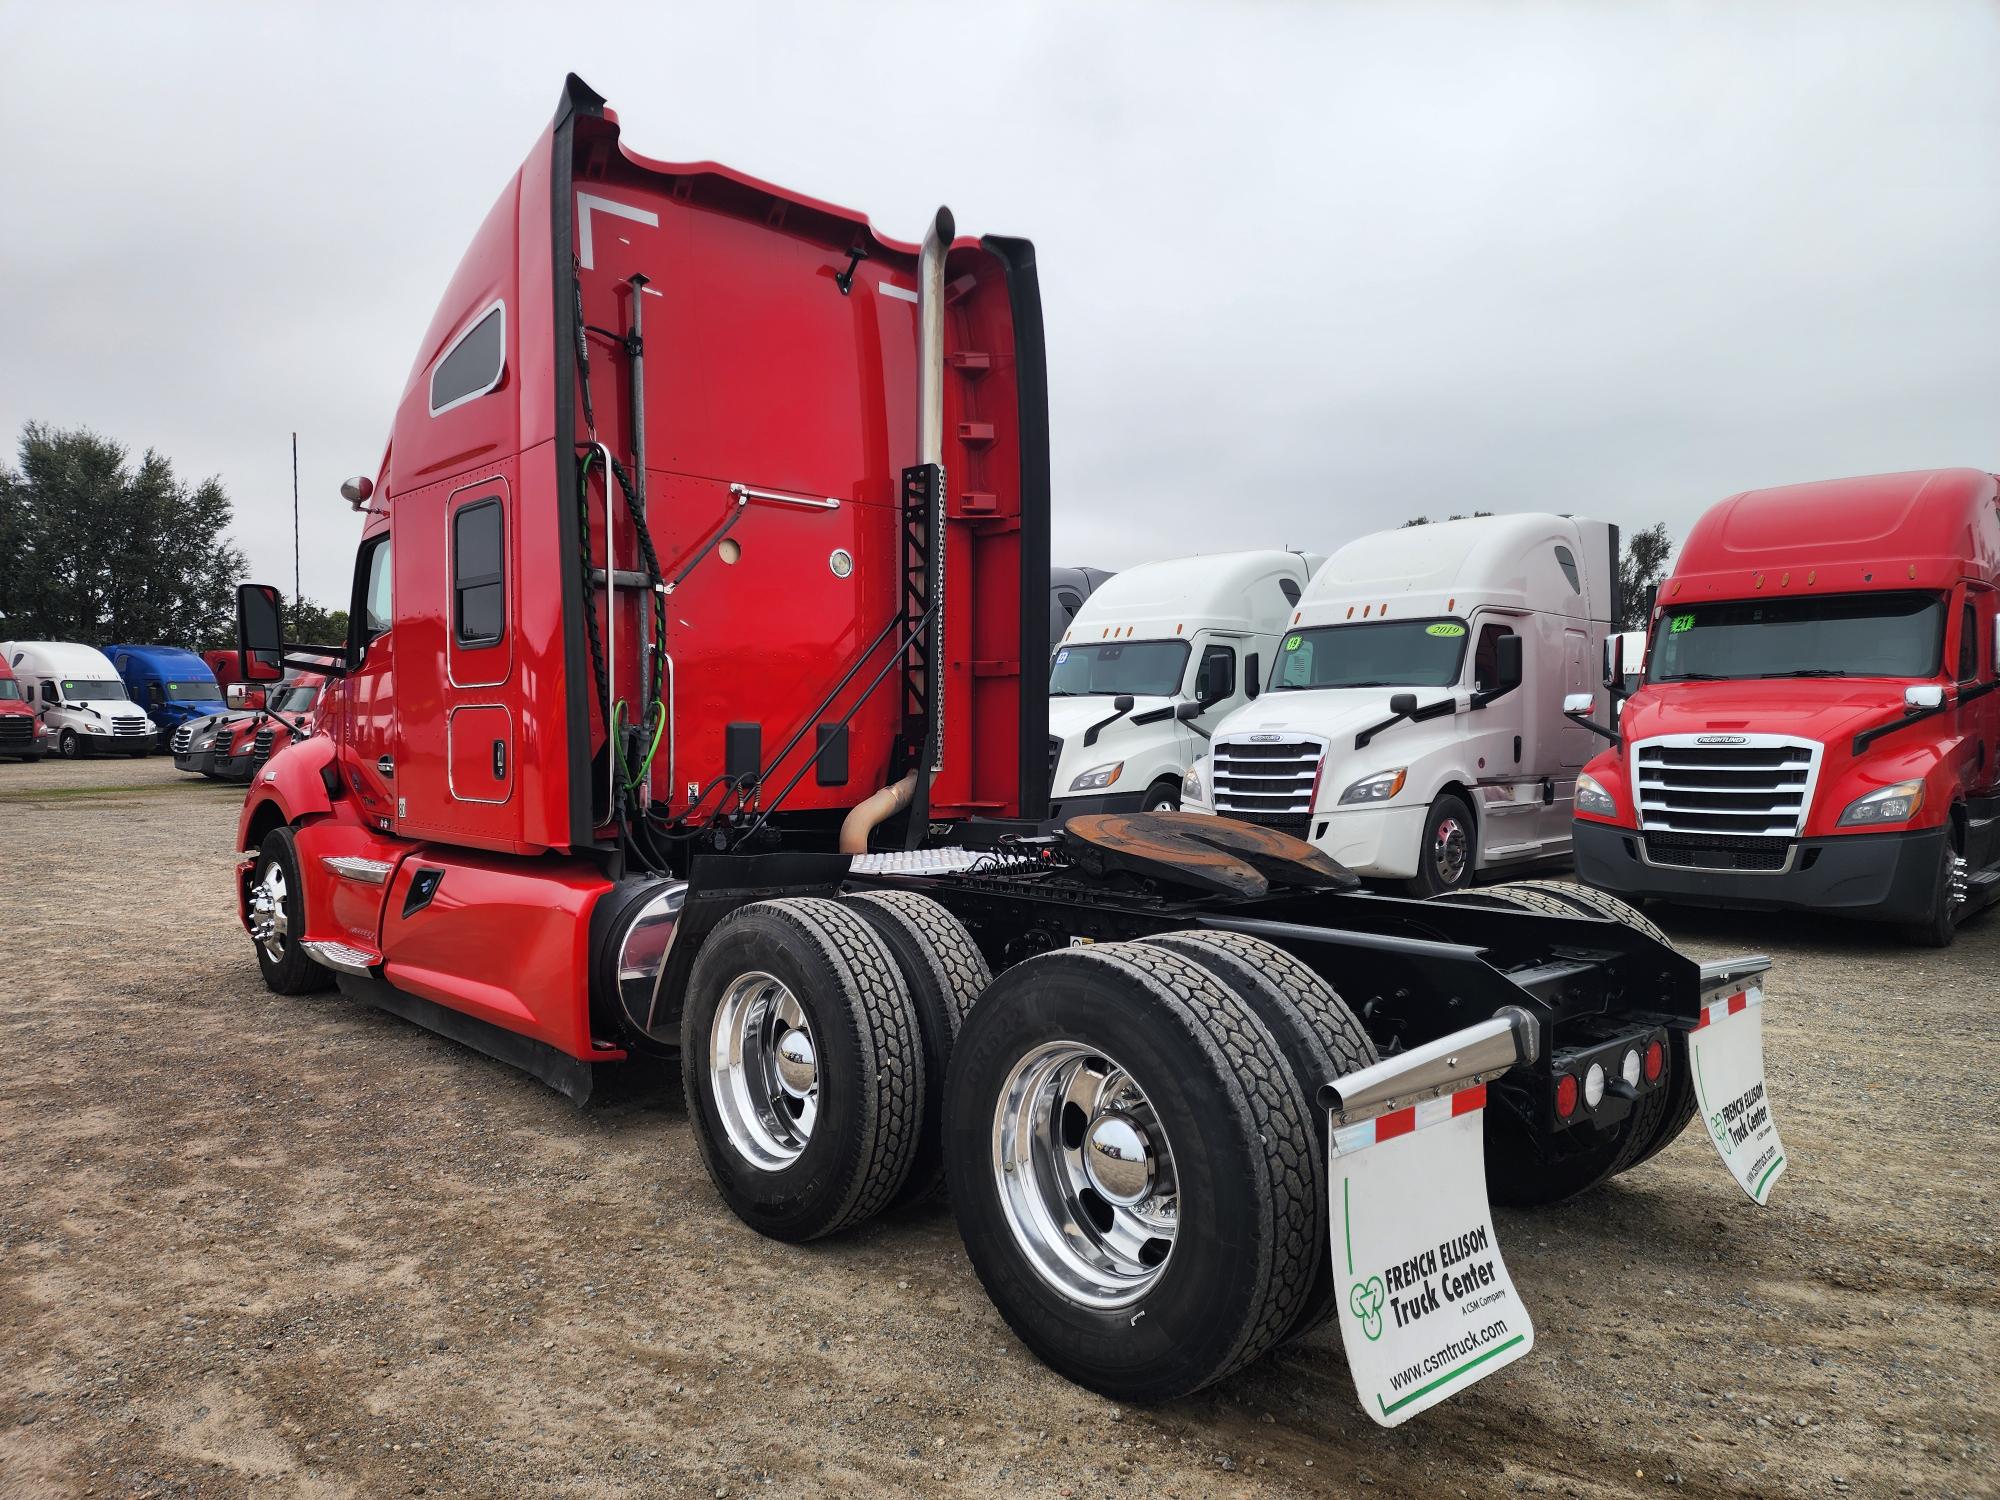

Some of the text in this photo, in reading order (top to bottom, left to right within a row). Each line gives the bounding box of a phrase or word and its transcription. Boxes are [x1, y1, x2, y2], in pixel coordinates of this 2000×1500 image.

[1432, 626, 1460, 635] 2019
[1675, 617, 1690, 630] 21
[1722, 1080, 1764, 1126] FRENCH ELLISON
[1728, 1116, 1749, 1148] Truck
[1746, 1105, 1768, 1132] Center
[1384, 1224, 1489, 1295] FRENCH ELLISON
[1390, 1260, 1496, 1328] Truck Center
[1461, 1288, 1507, 1316] A CSM Company
[1389, 1319, 1509, 1391] www.csmtruck.com
